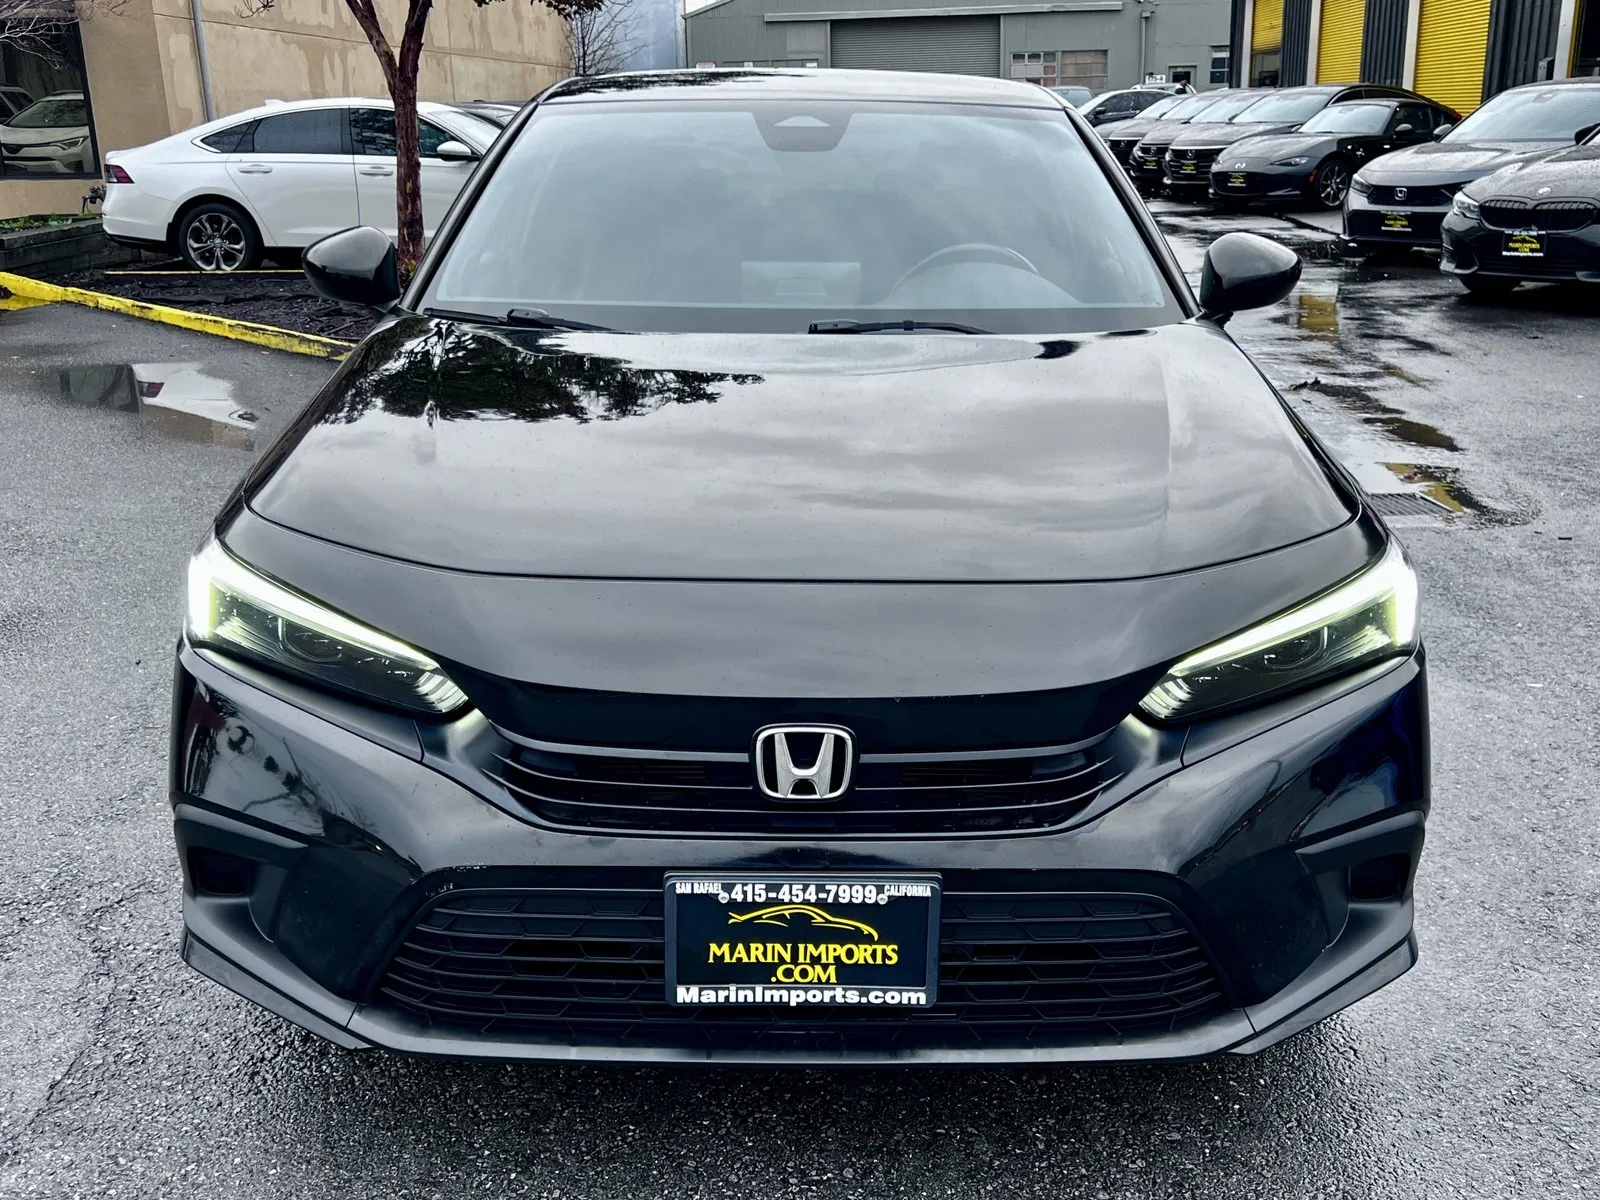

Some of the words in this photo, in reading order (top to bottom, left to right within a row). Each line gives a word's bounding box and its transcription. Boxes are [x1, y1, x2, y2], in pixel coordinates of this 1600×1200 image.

[675, 882, 692, 894] SAN
[693, 882, 723, 894] RAFAEL
[730, 883, 877, 904] 415-454-7999
[884, 884, 932, 897] CALIFORNIA
[708, 943, 792, 963] MARIN
[798, 943, 898, 965] IMPORTS
[770, 964, 838, 983] .COM
[676, 984, 927, 1007] MarinImports.com
